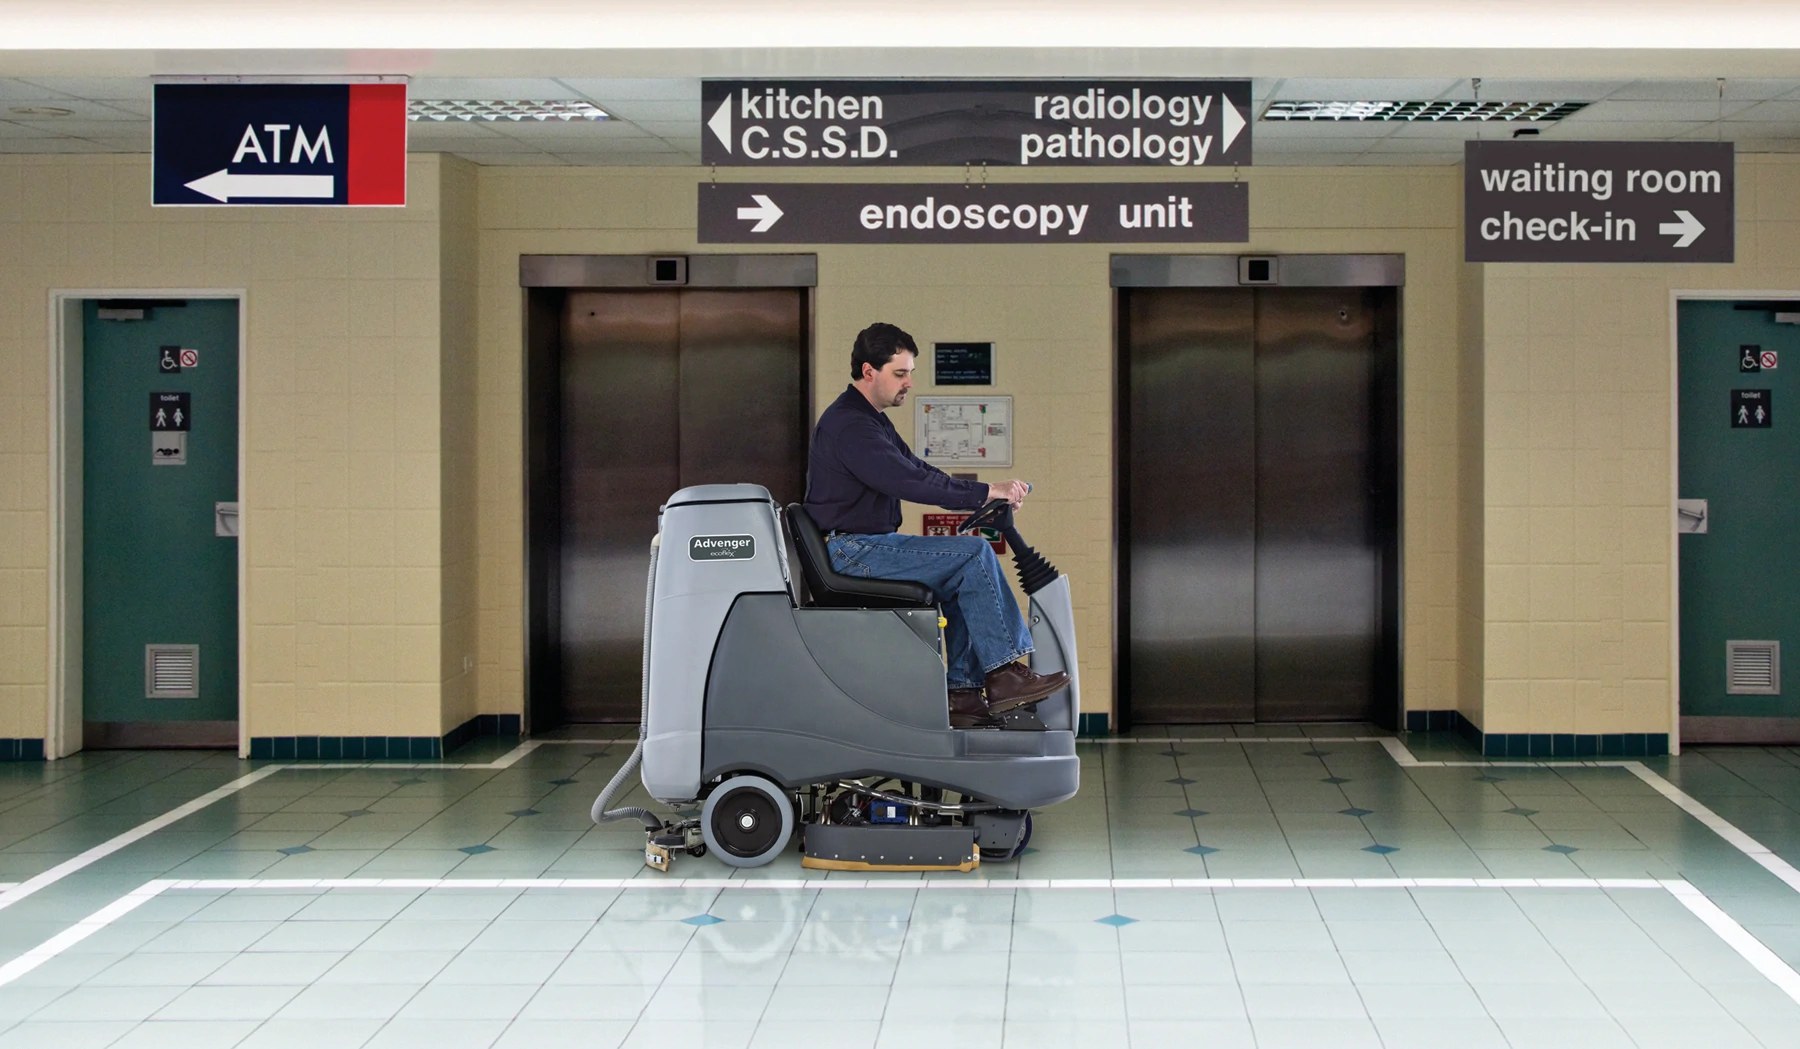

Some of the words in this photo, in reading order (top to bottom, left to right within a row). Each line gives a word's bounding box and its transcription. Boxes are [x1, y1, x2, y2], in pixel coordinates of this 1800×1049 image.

[741, 88, 883, 120] kitchen
[1034, 88, 1213, 126] radiology
[233, 124, 333, 164] ATM
[741, 125, 898, 160] C.S.S.D.
[1021, 127, 1213, 166] pathology
[1480, 162, 1613, 200] waiting
[1626, 169, 1721, 193] room
[859, 197, 1089, 235] endoscopy
[1119, 196, 1194, 228] unit
[1480, 210, 1636, 241] check-in
[694, 538, 751, 549] Advenger
